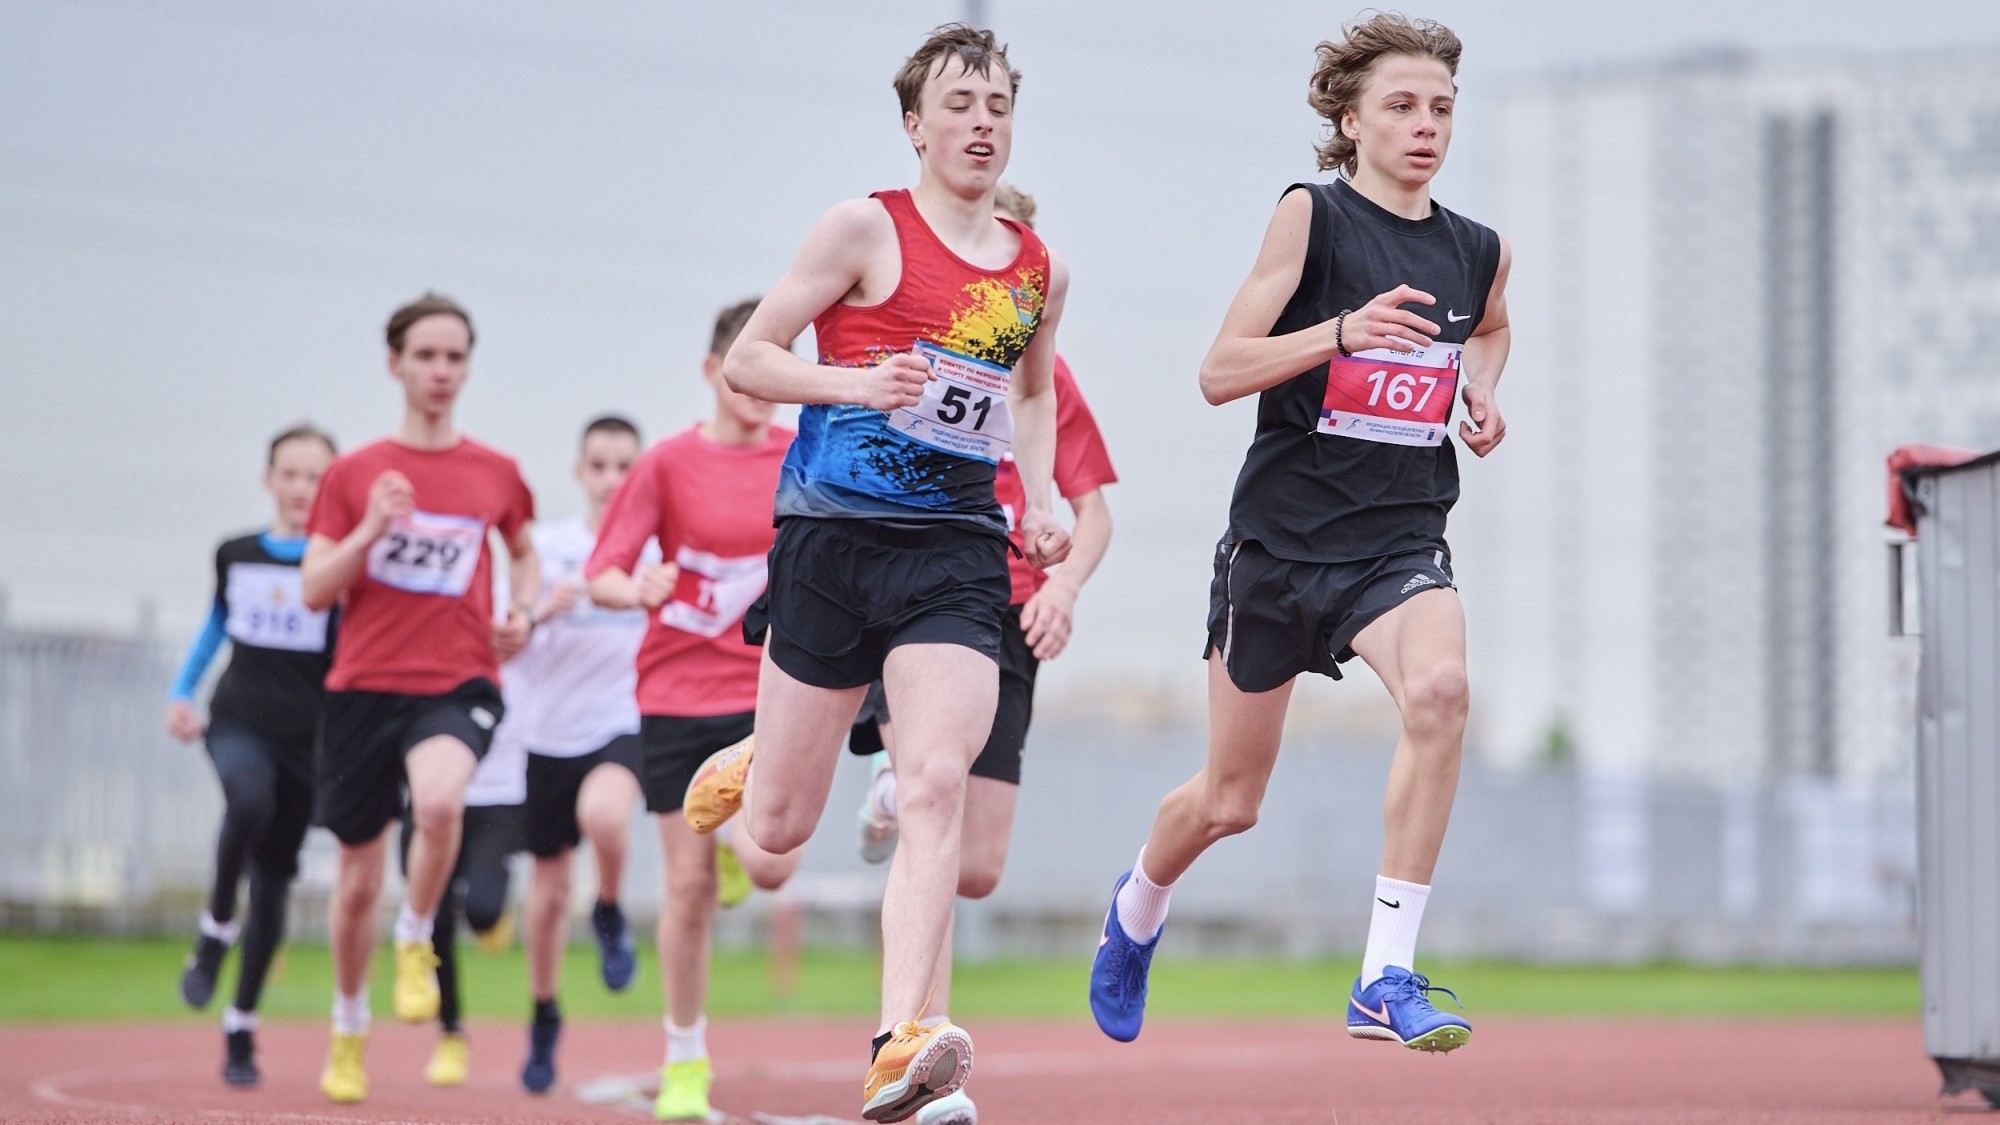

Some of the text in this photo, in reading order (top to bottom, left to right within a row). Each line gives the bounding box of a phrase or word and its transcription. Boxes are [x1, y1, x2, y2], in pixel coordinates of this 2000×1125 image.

[936, 385, 992, 431] 51
[1366, 370, 1438, 413] 167
[386, 532, 461, 571] 229
[1400, 579, 1437, 594] adidas
